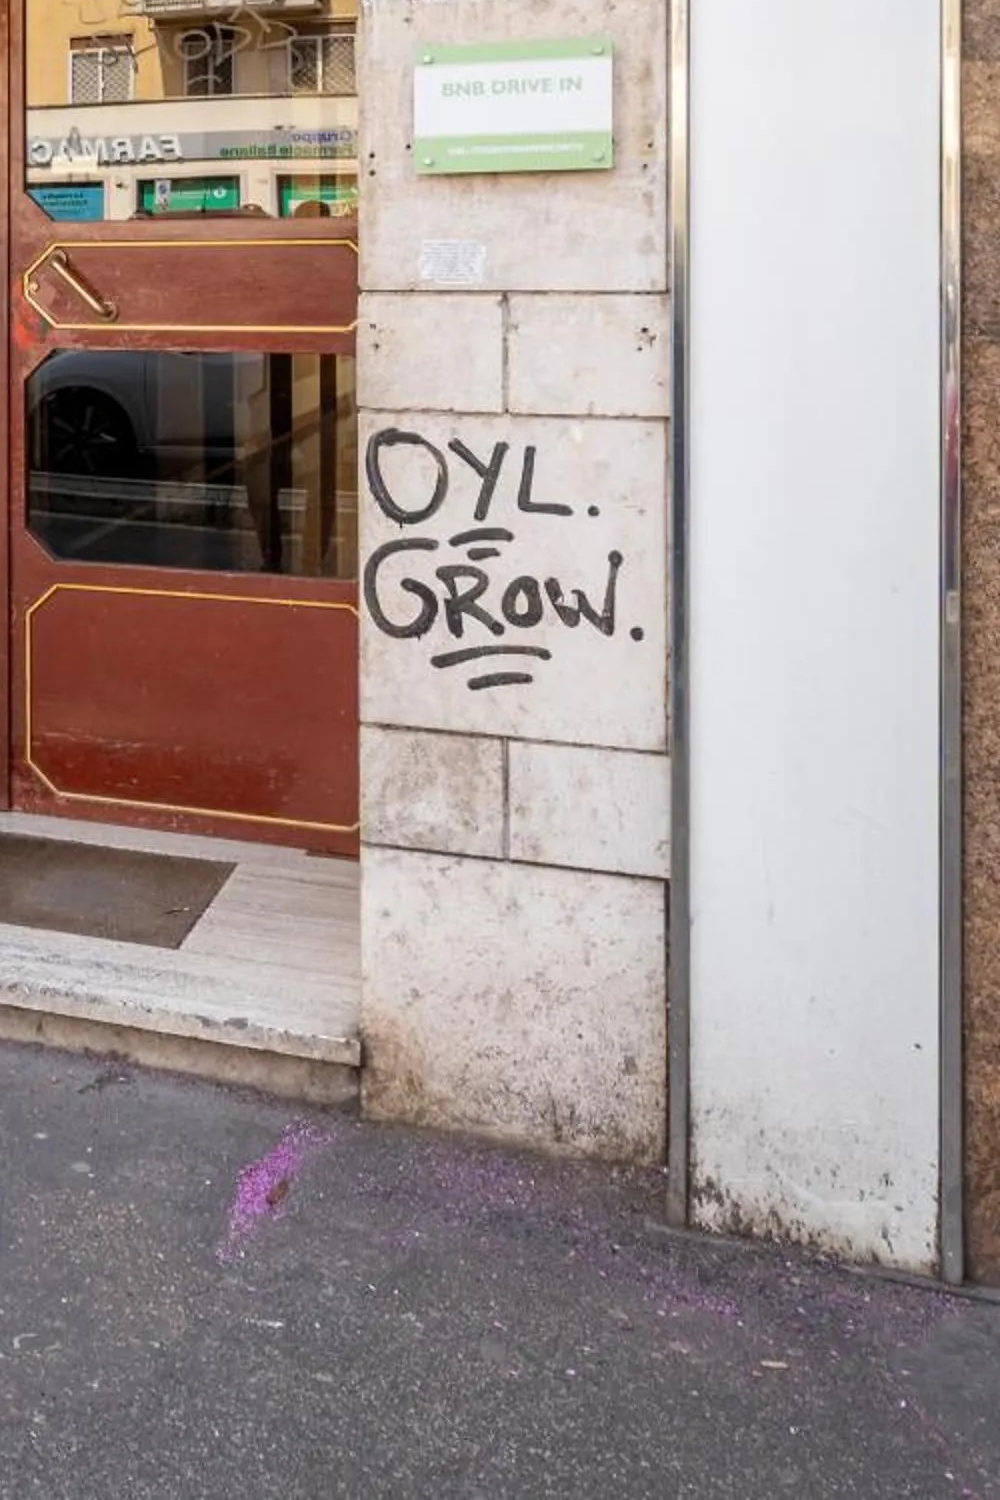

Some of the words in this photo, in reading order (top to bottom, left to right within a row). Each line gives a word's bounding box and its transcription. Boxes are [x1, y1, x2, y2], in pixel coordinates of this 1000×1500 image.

[441, 80, 486, 98] BNB
[491, 77, 552, 96] DRIVE
[559, 75, 583, 93] IN
[363, 537, 645, 641] GROW.
